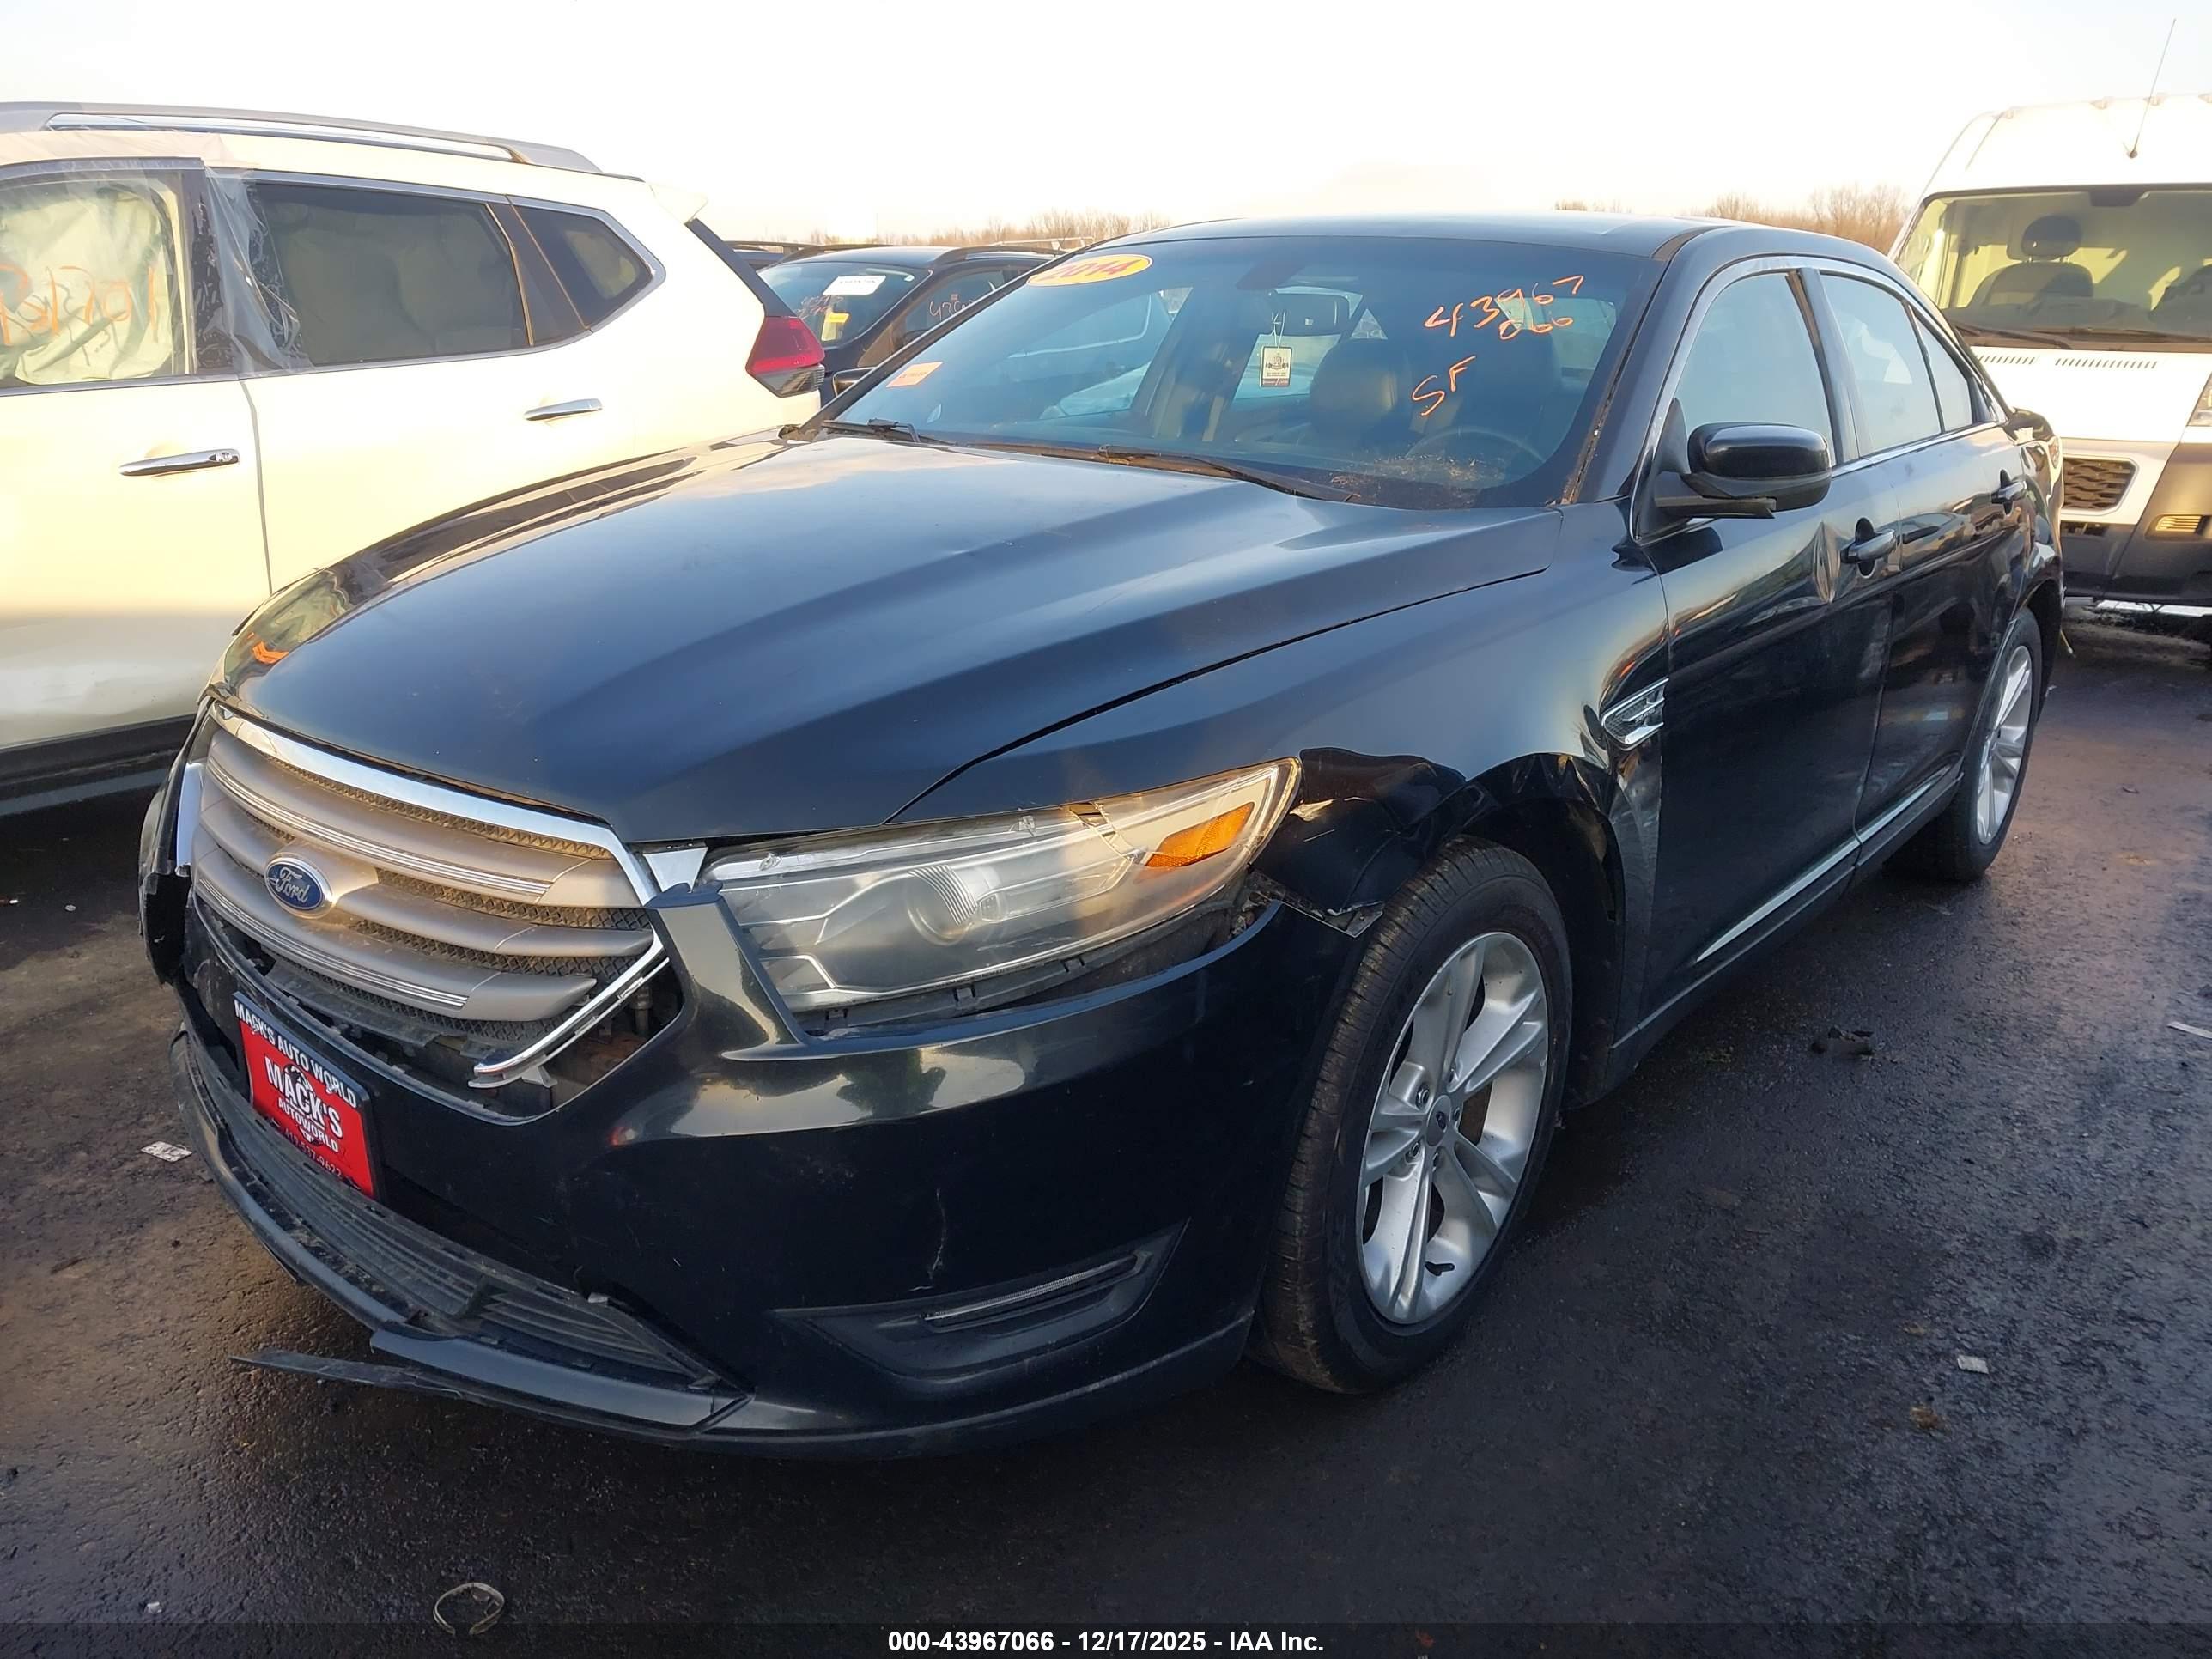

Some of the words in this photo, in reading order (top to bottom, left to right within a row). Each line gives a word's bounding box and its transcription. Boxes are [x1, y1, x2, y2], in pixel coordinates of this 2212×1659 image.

[1424, 275, 1584, 337] 43967
[1412, 355, 1476, 416] SF
[267, 866, 310, 903] Ford
[234, 999, 276, 1046] MACK'S
[277, 1035, 309, 1072] AUTO
[310, 1060, 357, 1109] WORLD
[264, 1054, 343, 1139] MACK'S
